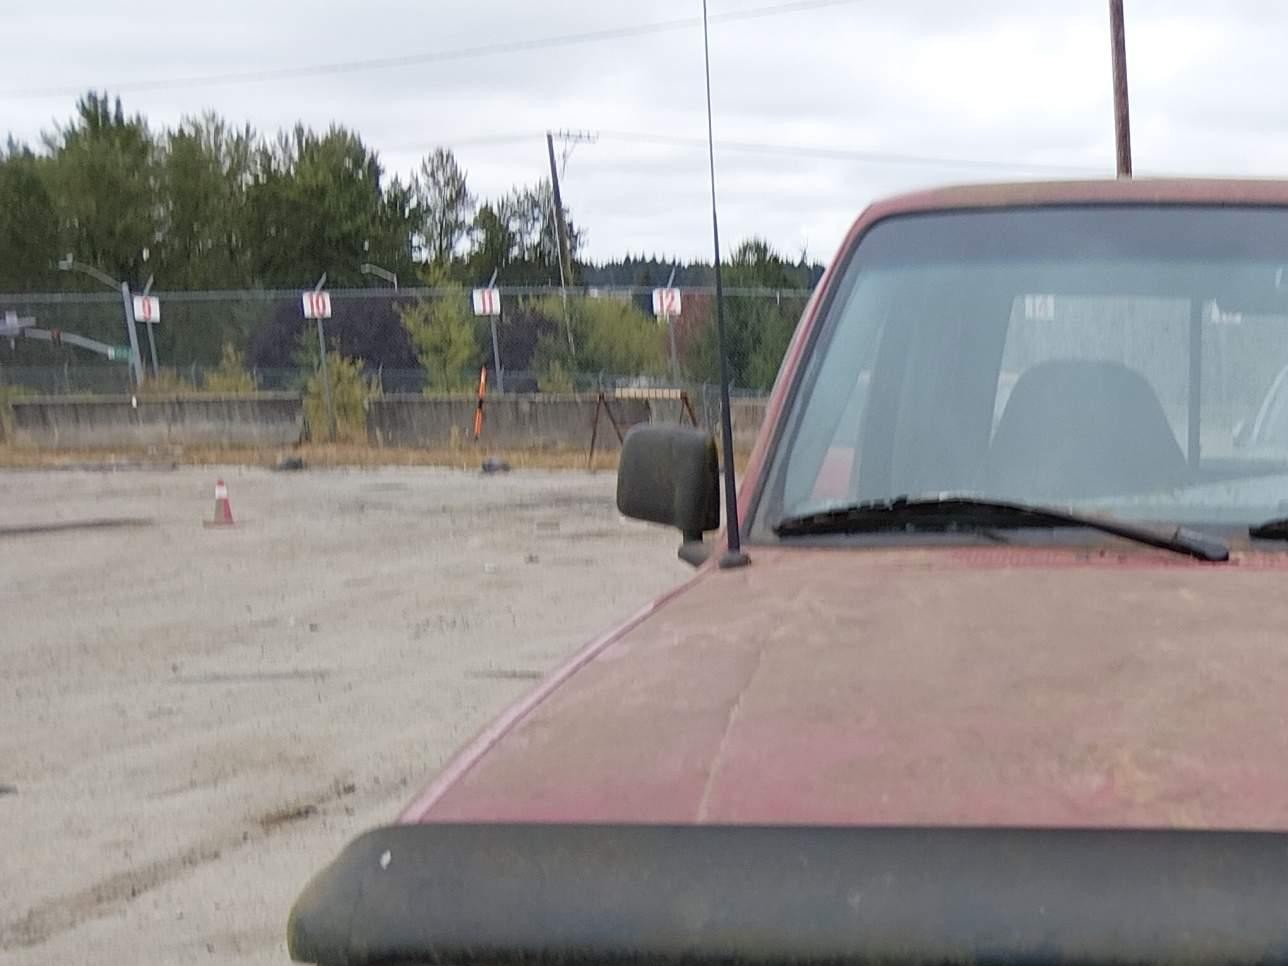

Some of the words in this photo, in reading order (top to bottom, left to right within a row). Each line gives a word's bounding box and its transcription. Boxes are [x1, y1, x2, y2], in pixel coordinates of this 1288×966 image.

[309, 293, 327, 317] 10
[481, 289, 494, 315] 11
[658, 289, 675, 315] 12
